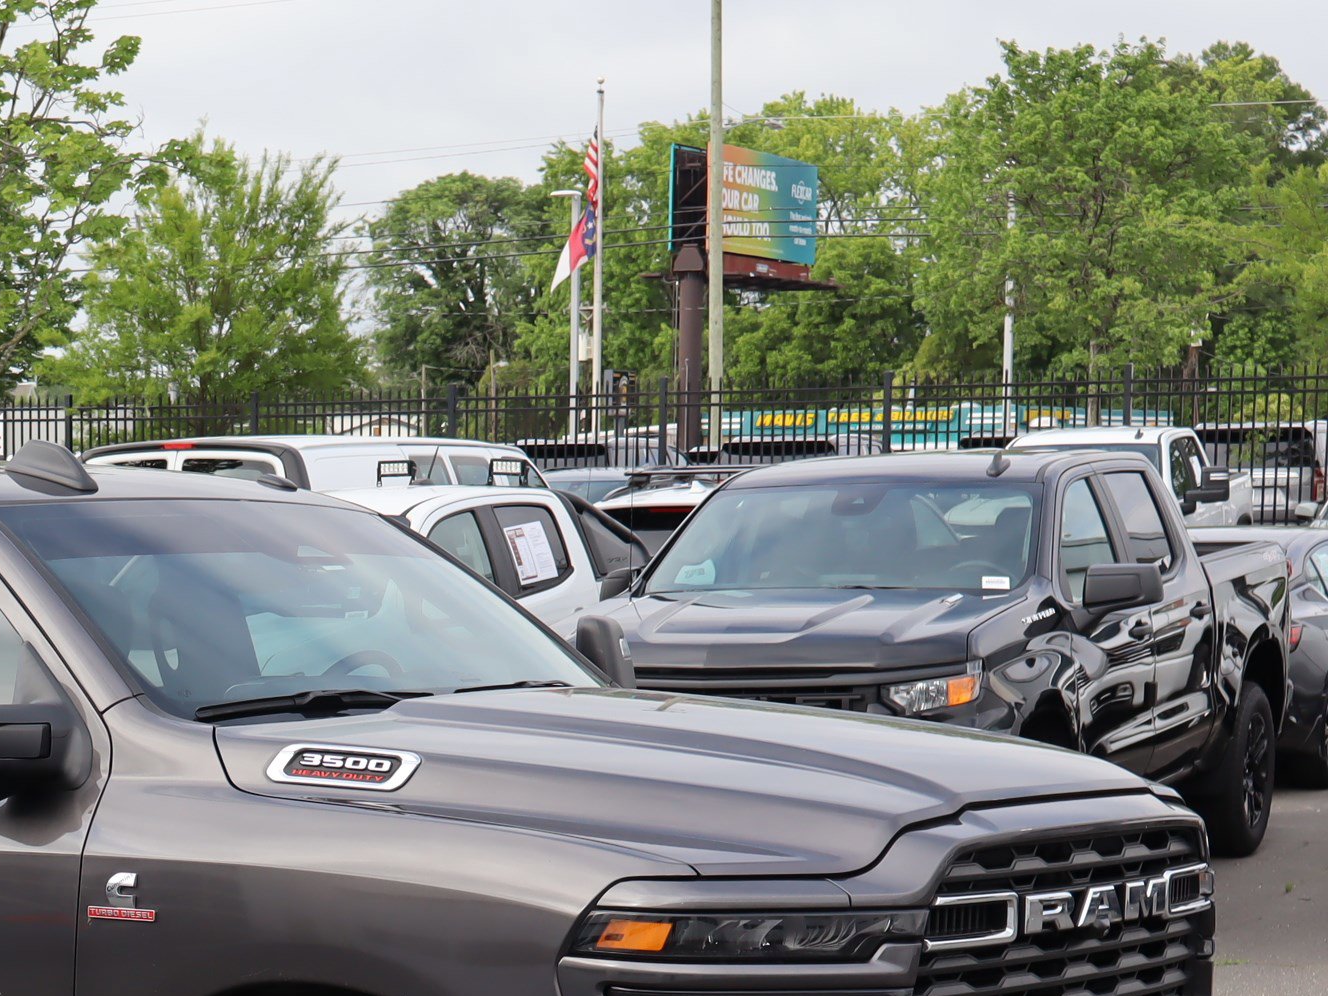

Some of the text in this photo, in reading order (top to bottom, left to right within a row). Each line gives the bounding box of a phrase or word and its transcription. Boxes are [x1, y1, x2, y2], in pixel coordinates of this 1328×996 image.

[723, 162, 778, 191] FE CHANGES.
[722, 188, 760, 213] OUR CAR
[756, 413, 815, 427] MAVIS
[299, 753, 392, 772] 3500
[292, 769, 384, 781] HEAVY DUTY
[89, 908, 153, 919] TURBO DIESEL
[1024, 878, 1169, 934] RAM
